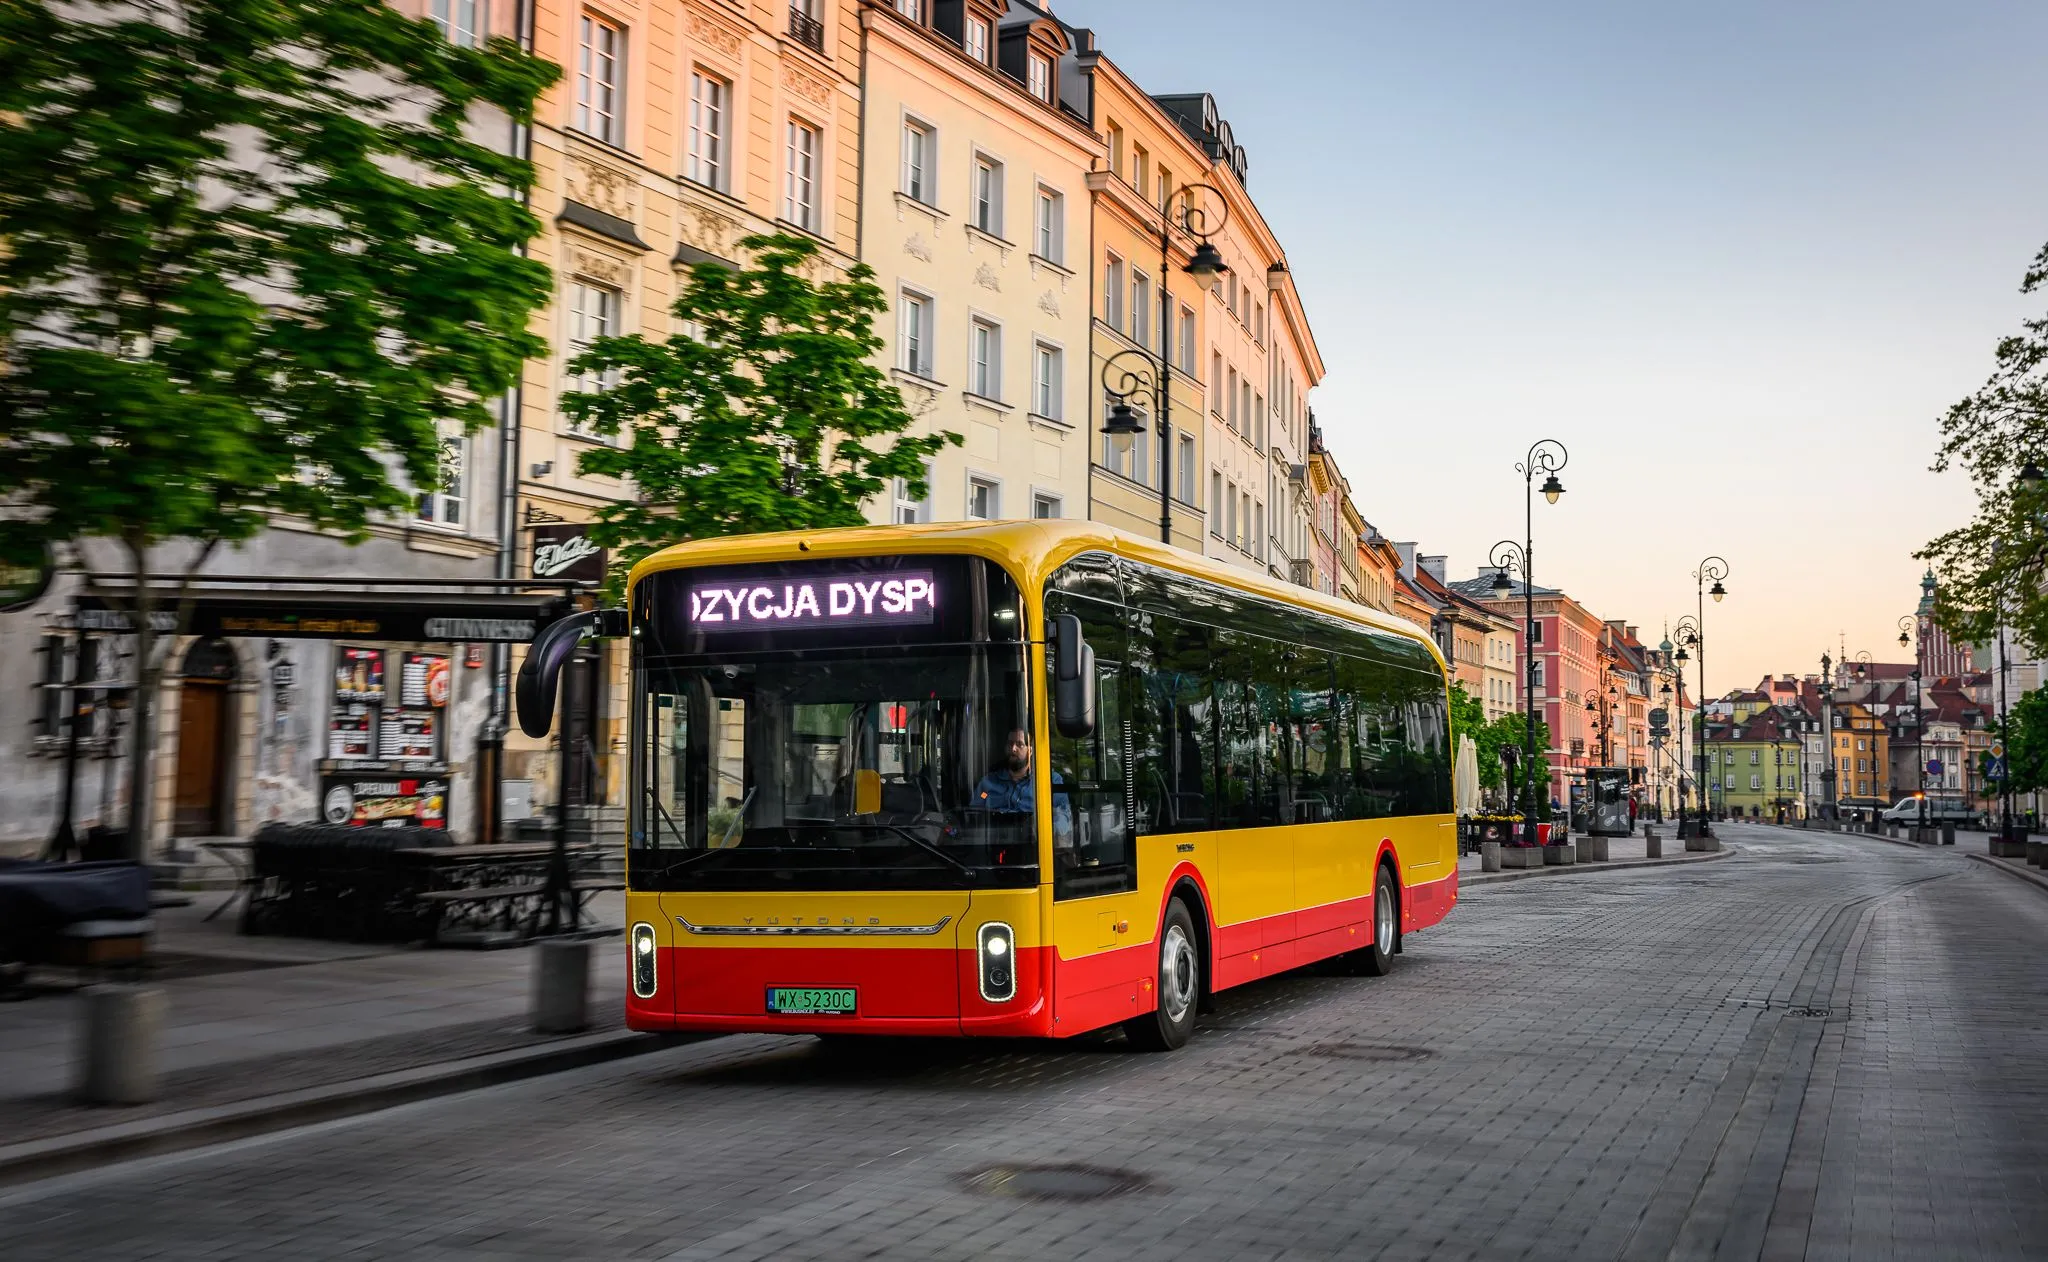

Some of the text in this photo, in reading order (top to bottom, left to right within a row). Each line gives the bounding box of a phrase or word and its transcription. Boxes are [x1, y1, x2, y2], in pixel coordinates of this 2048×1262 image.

[692, 578, 935, 621] ZYCJA DYSP
[743, 916, 880, 925] YUTONG
[778, 991, 852, 1008] WX 5230C
